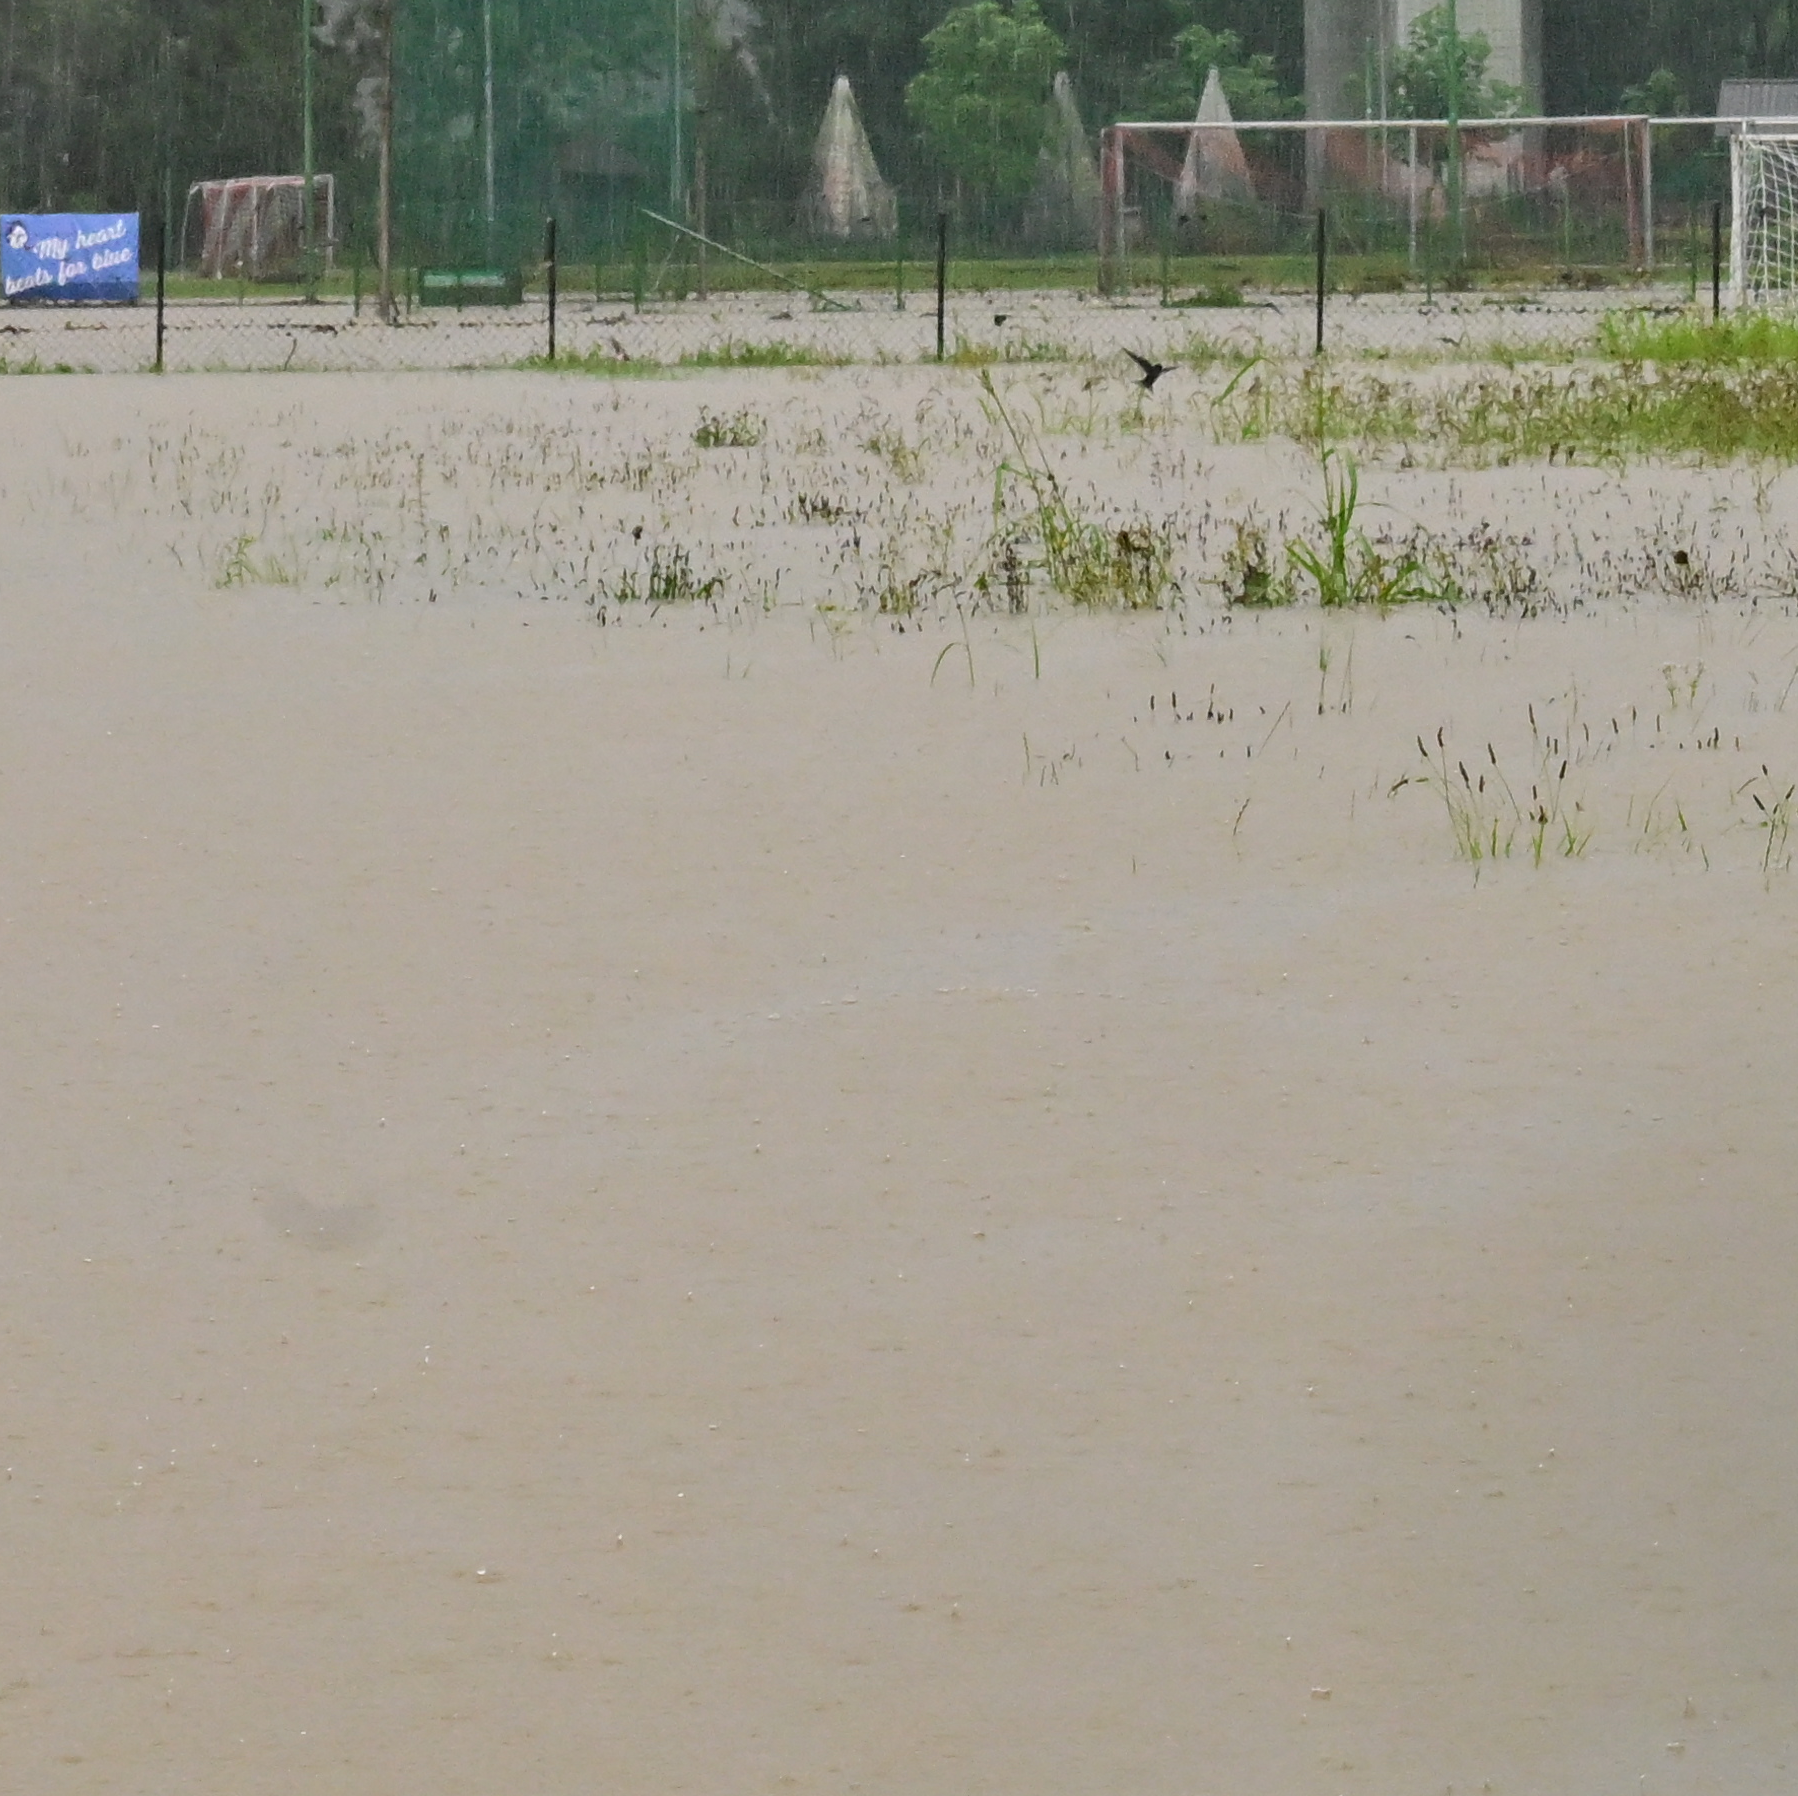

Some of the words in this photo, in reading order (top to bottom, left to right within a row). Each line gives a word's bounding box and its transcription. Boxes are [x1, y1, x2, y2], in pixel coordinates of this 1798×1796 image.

[33, 237, 68, 260] My
[74, 218, 127, 250] heart
[5, 266, 53, 295] beats
[57, 260, 88, 287] for
[91, 247, 133, 271] blue
